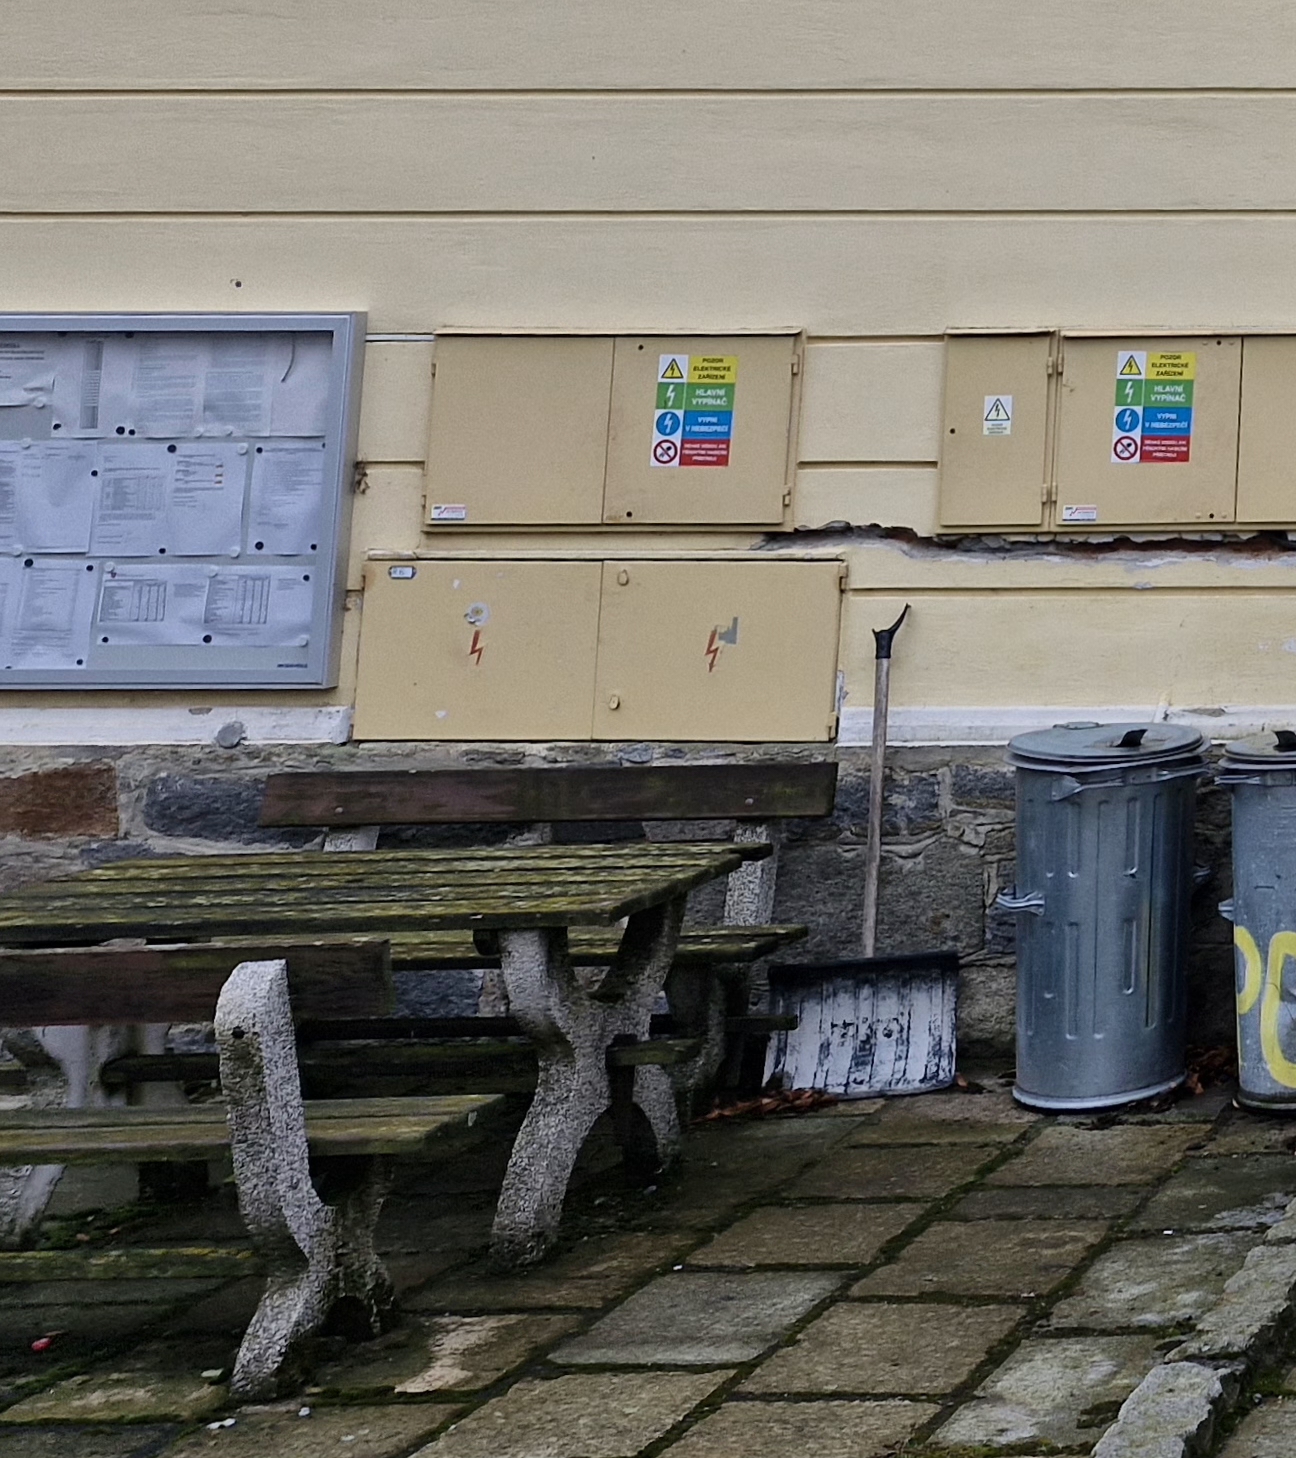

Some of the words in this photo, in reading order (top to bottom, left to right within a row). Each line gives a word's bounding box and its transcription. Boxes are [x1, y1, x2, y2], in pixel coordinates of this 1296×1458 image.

[695, 388, 726, 396] HLAVNÍ
[1154, 384, 1184, 392] HLAVNÍ
[691, 397, 728, 406] VYPÍNAČ
[1150, 393, 1187, 402] VYPÍNAČ
